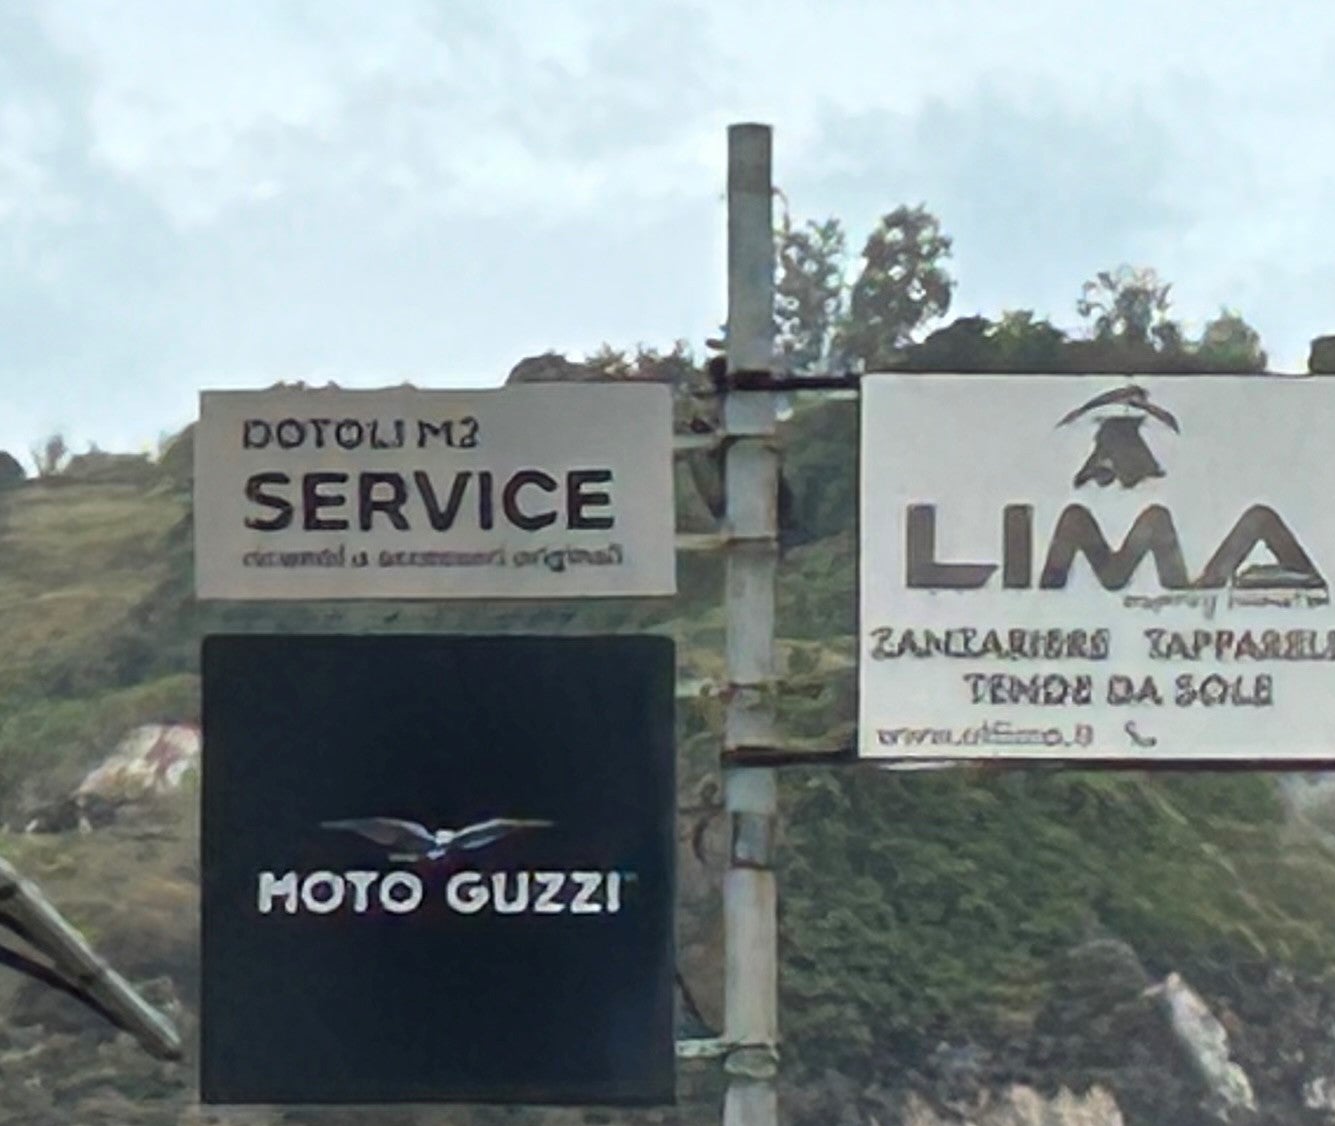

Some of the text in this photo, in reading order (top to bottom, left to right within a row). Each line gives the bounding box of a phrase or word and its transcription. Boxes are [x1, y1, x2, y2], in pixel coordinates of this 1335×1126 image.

[242, 416, 480, 450] DOTOLI M2
[243, 469, 615, 531] SERVICE
[906, 503, 1328, 590] LIMA
[870, 627, 1110, 661] ZANZARIERE
[963, 673, 1275, 706] TENDE DA SOLE
[258, 871, 622, 914] MOTO GUZZI
